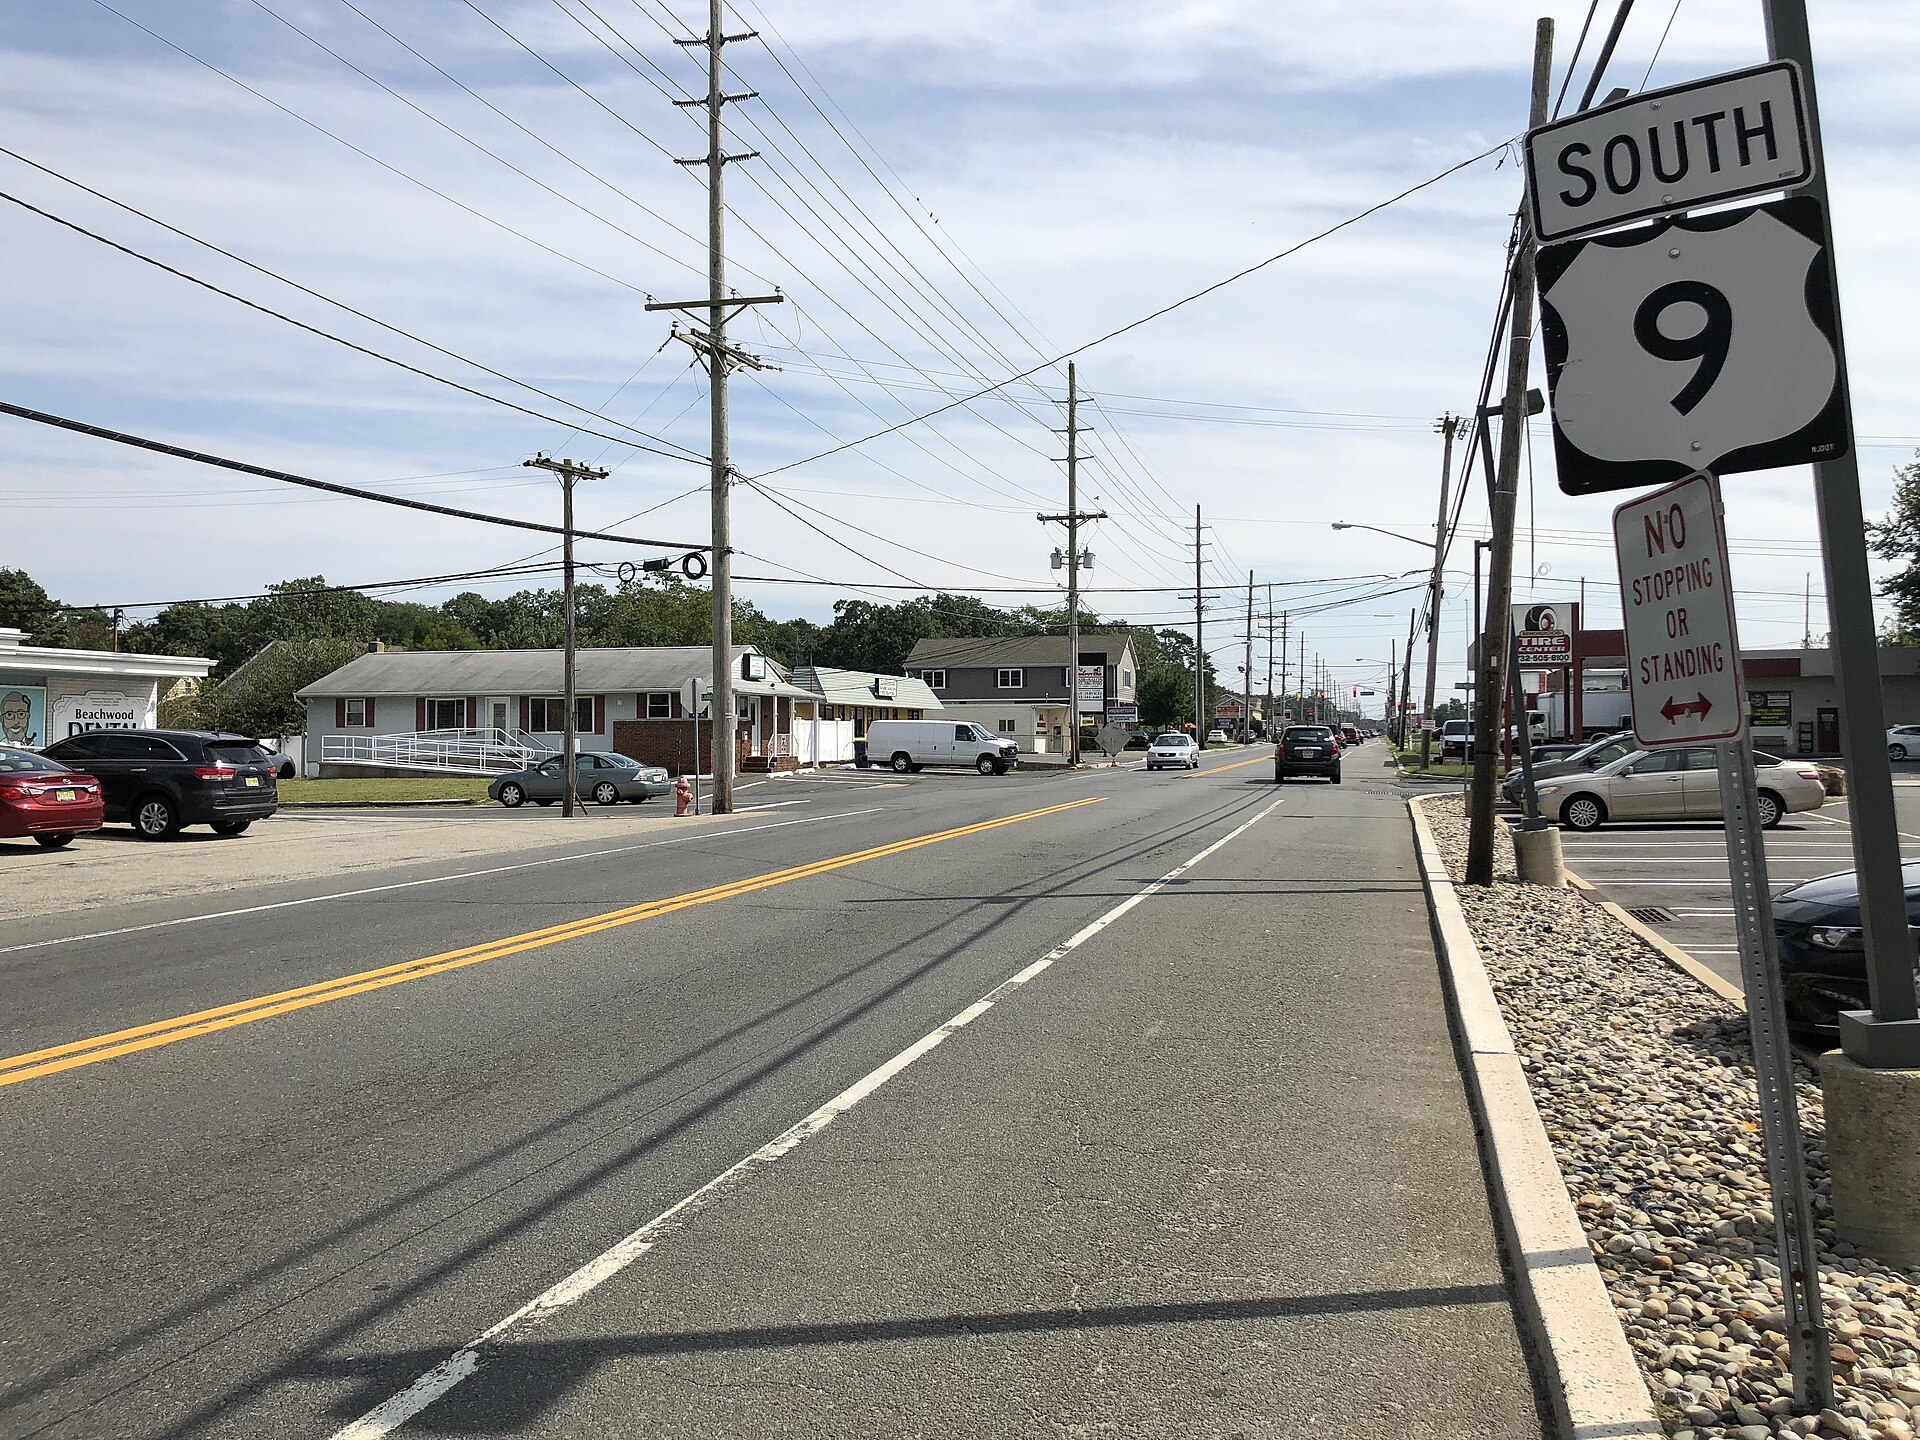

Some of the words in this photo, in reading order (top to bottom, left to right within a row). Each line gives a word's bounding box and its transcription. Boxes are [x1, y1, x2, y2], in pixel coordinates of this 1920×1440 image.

[1557, 100, 1778, 208] SOUTH
[1633, 280, 1732, 417] 9
[1811, 443, 1835, 454] NJDOT
[1643, 503, 1686, 558] NO
[1632, 557, 1713, 606] STOPPING
[1518, 637, 1566, 646] TIRE
[1666, 607, 1689, 639] OR
[1640, 642, 1723, 685] STANDING
[75, 709, 134, 719] Beachwood
